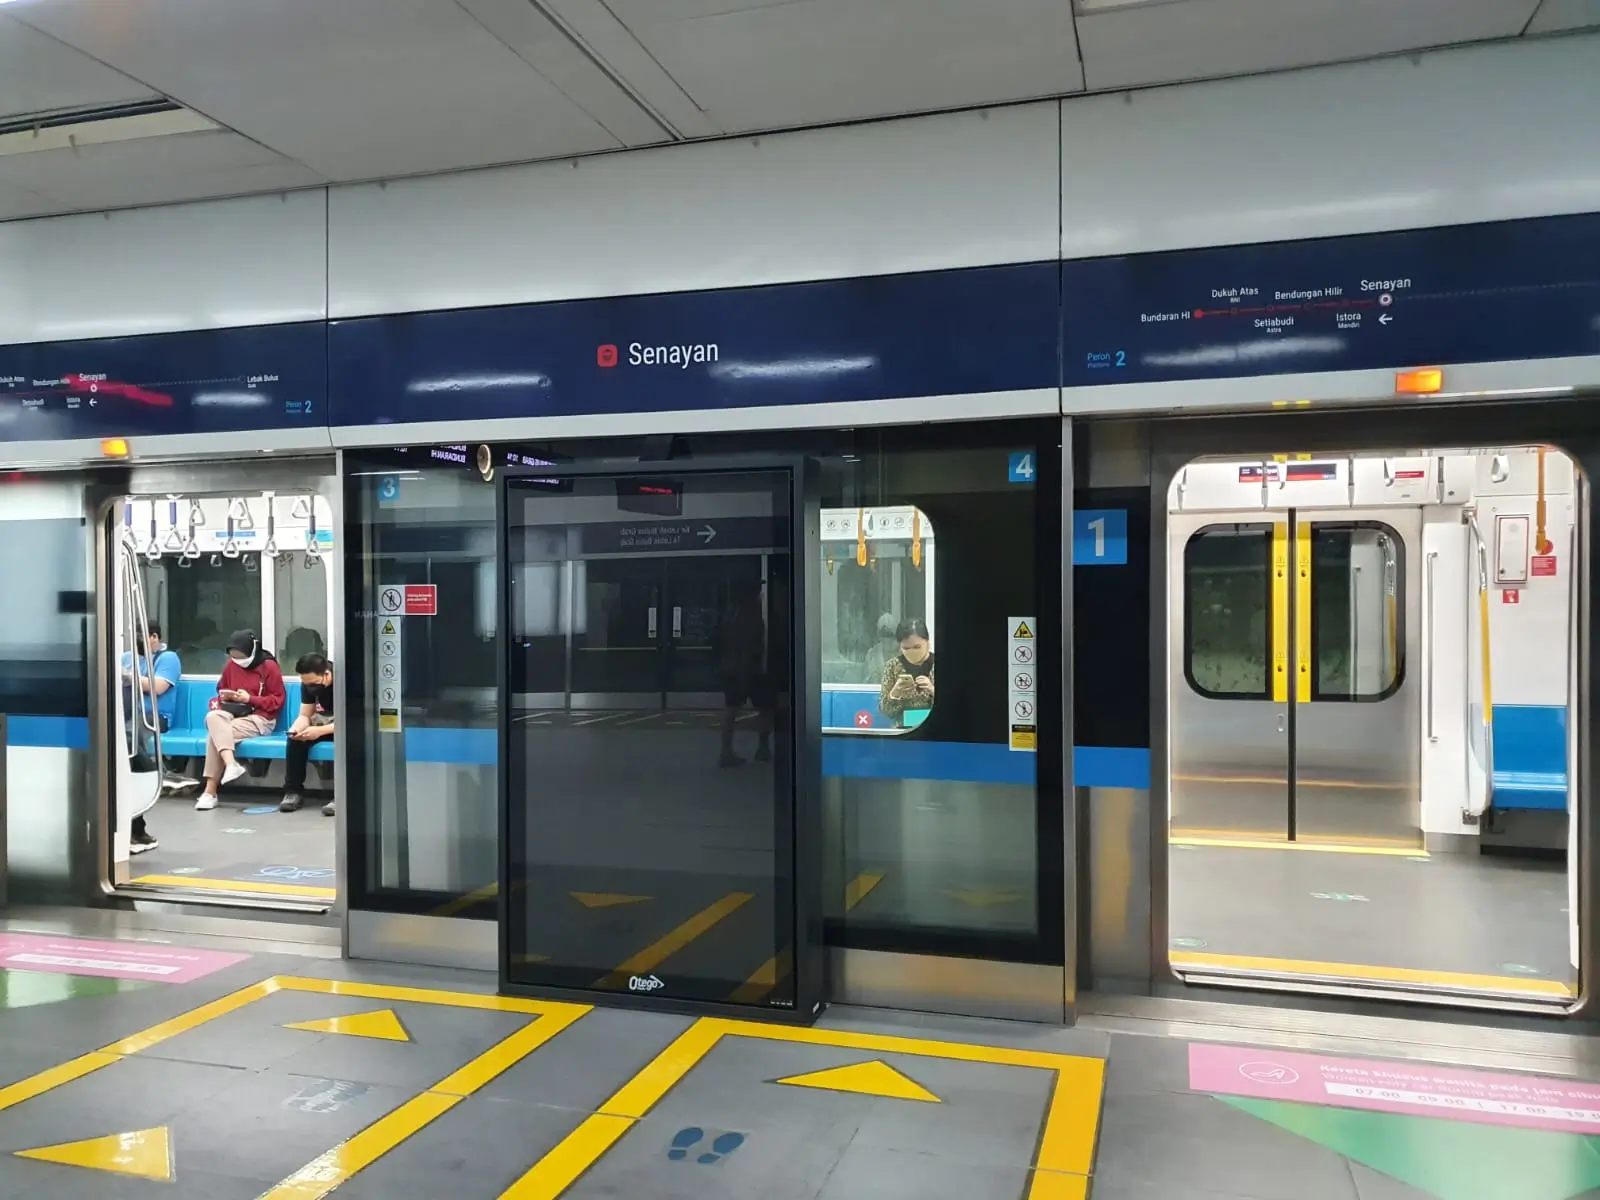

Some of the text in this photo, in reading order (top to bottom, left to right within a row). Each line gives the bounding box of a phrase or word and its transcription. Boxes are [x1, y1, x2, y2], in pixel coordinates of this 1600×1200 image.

[1360, 278, 1411, 292] Senayan
[1211, 287, 1259, 298] Dukuh Atas
[1274, 287, 1344, 300] Bendungan Hilir
[1141, 311, 1190, 322] Bundaran HI
[1254, 316, 1295, 328] Setiabudi
[1336, 313, 1362, 322] Istora
[629, 342, 719, 370] Senayan
[1087, 350, 1127, 367] Peron 2
[79, 373, 107, 382] Senayan
[304, 400, 312, 413] 2
[1015, 453, 1034, 479] 4
[383, 477, 396, 498] 3
[1087, 517, 1105, 557] 1
